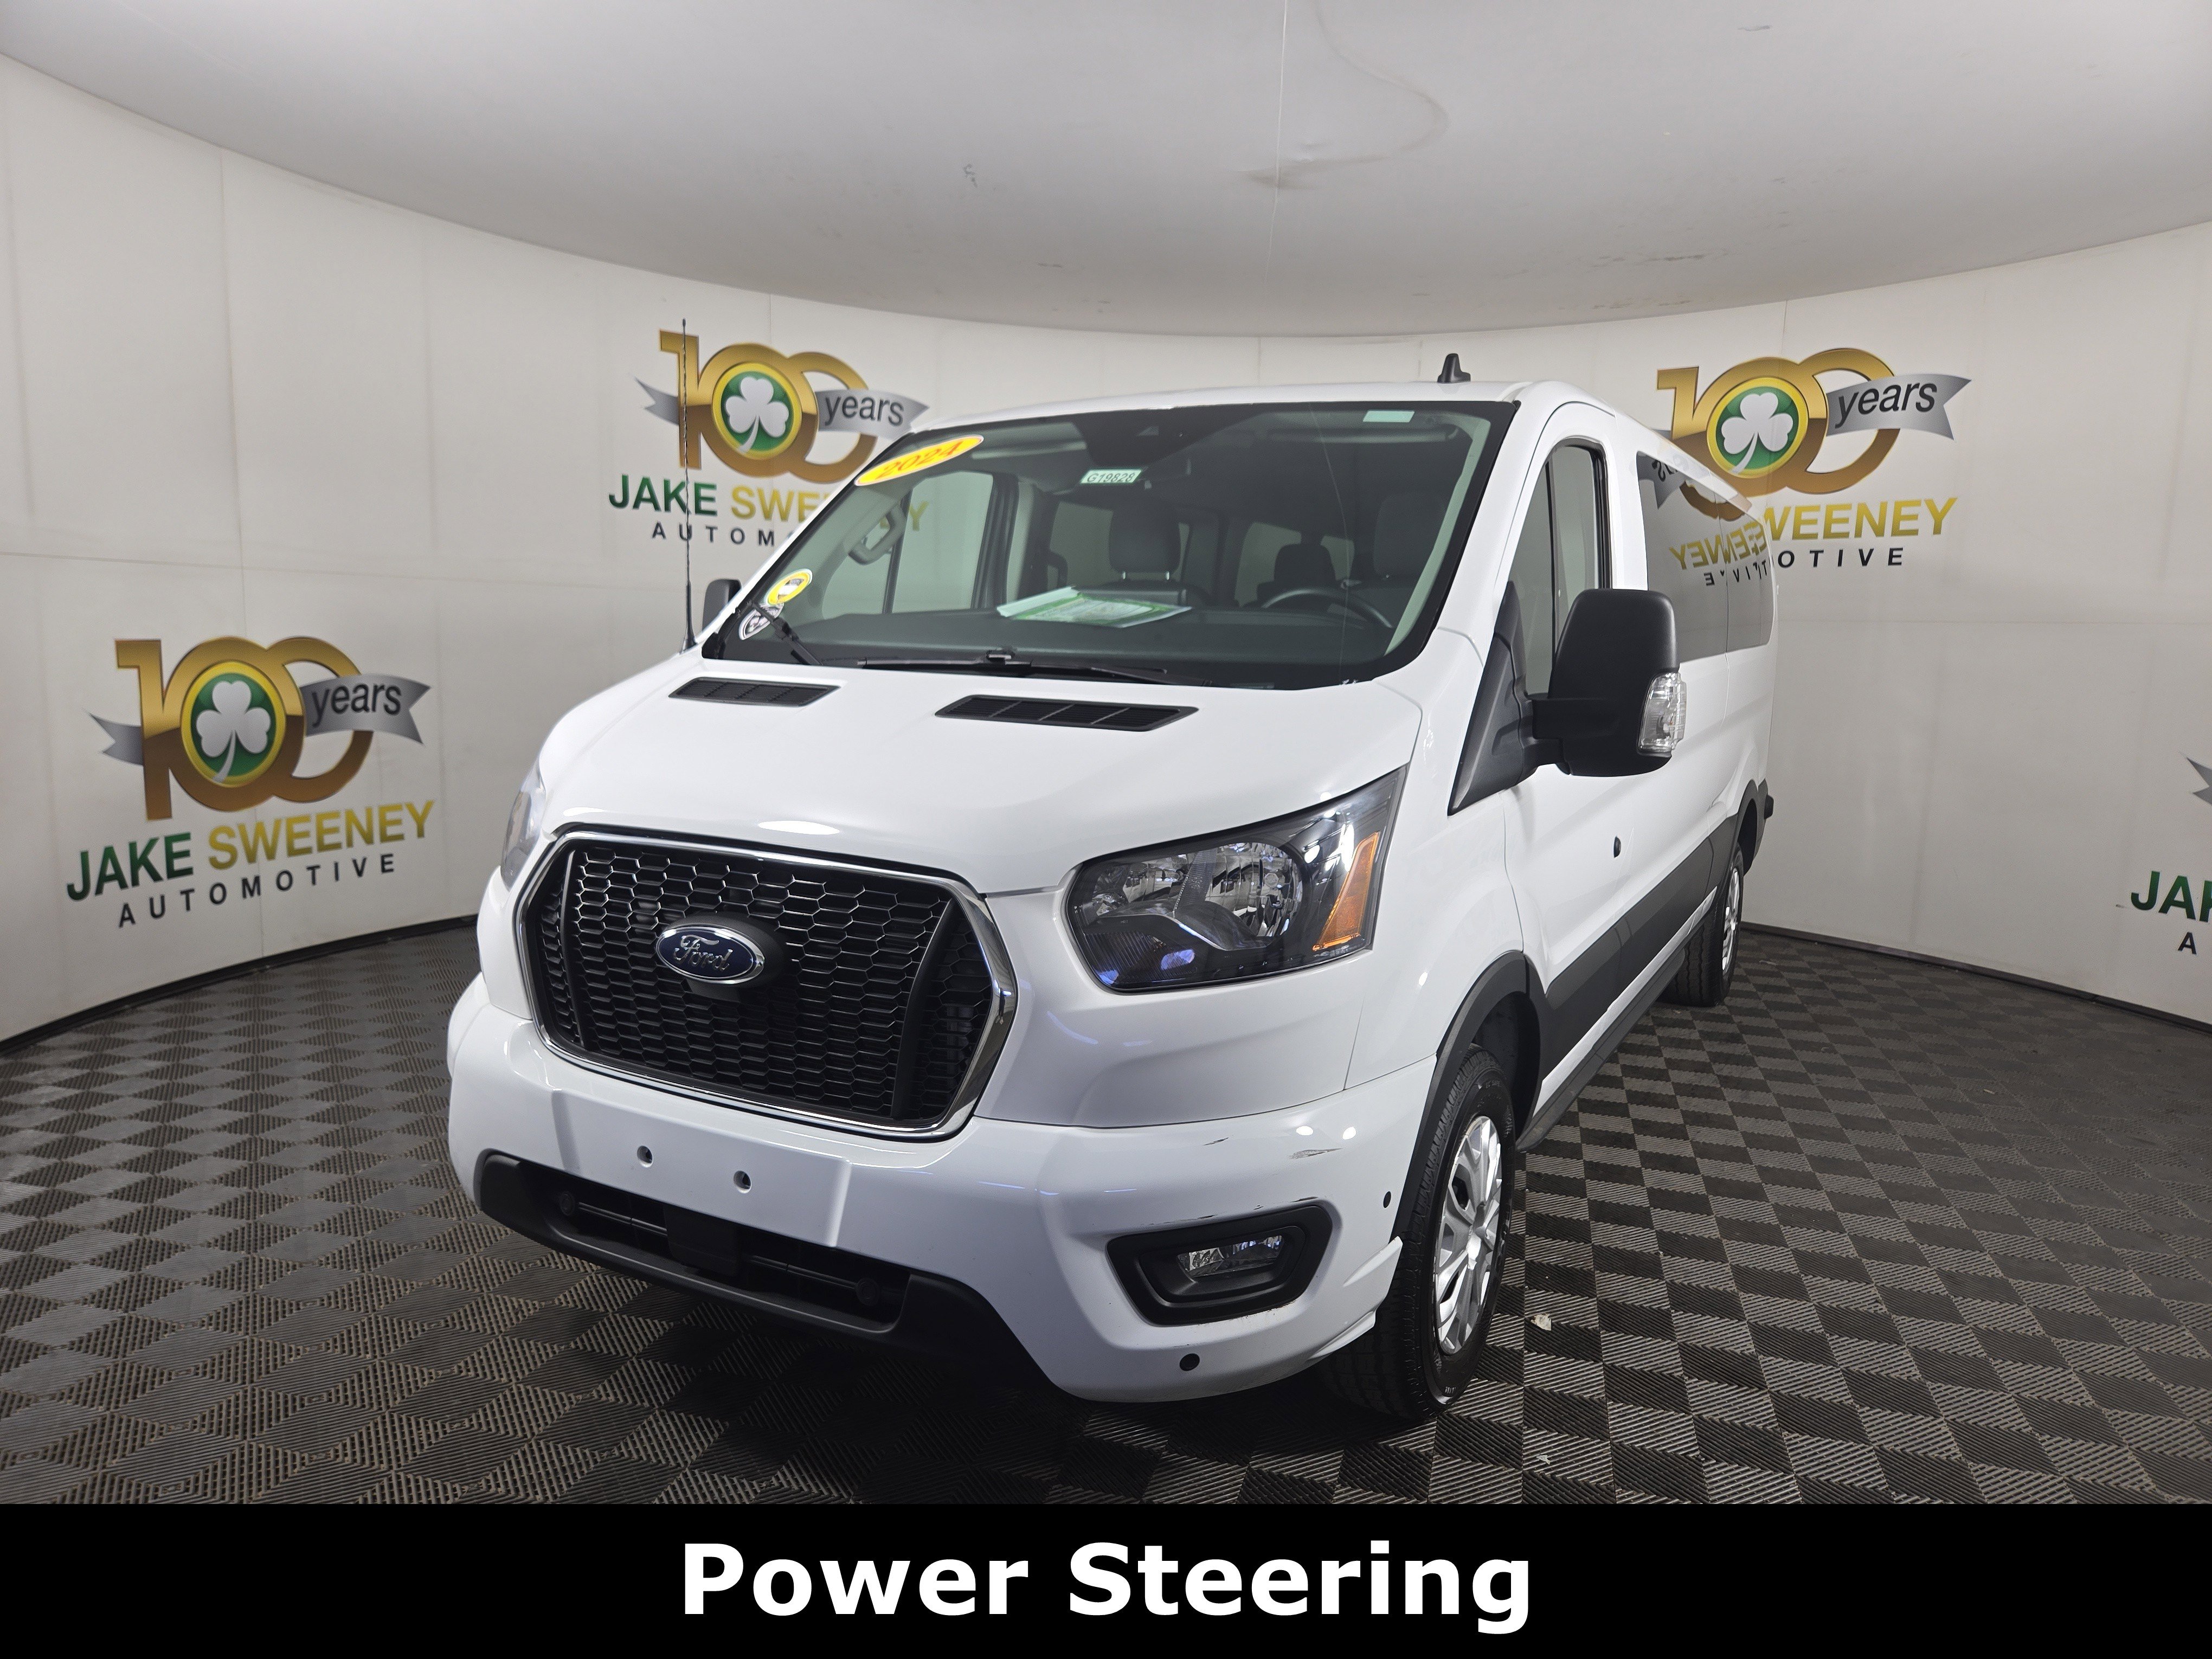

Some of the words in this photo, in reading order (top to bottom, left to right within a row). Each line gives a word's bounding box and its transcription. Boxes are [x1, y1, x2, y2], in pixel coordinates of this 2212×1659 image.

[824, 392, 904, 427] years
[1835, 382, 1938, 429] years
[874, 440, 964, 479] 2024
[608, 474, 718, 517] JAKE
[1770, 547, 1904, 569] OTIVE
[114, 636, 374, 821] 100
[312, 683, 402, 728] years
[66, 832, 194, 902] JAKE
[208, 800, 434, 871] SWEENEY
[118, 853, 395, 928] AUTOMOTIVE
[673, 935, 734, 971] Ford
